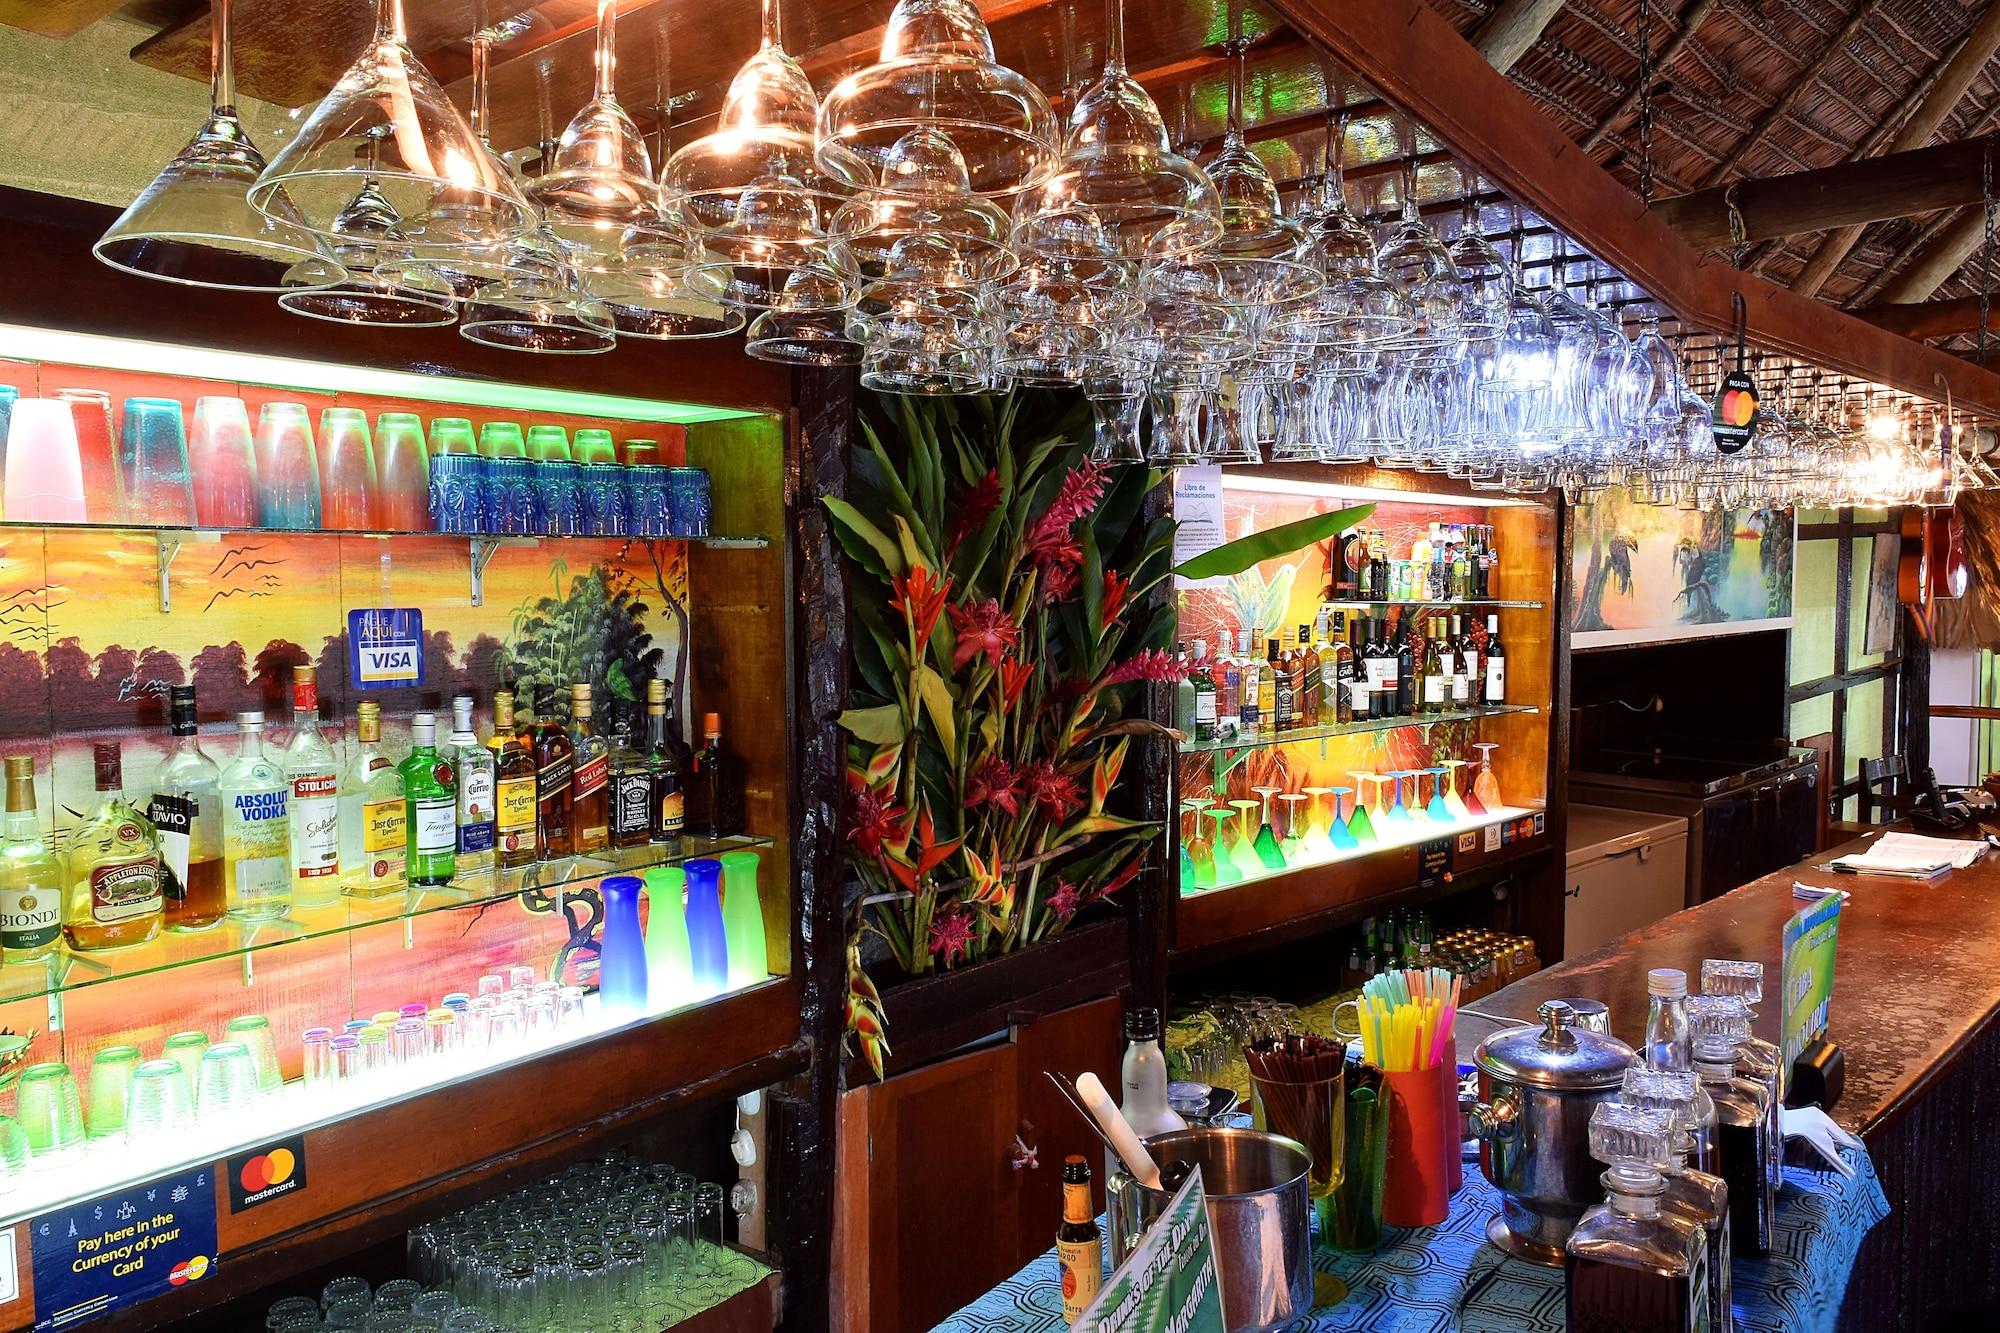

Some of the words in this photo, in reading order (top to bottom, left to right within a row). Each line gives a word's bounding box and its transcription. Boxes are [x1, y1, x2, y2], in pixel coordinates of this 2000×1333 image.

[1175, 491, 1216, 499] Reclamaciones
[359, 617, 389, 627] PAGUE
[368, 652, 412, 669] VISA
[579, 774, 592, 785] Red
[592, 764, 608, 776] Label
[468, 784, 490, 795] Cuervo
[235, 790, 288, 808] ABSOLUT
[504, 798, 518, 808] Jose
[518, 795, 536, 806] Cuervo
[242, 804, 287, 821] VODKA
[372, 819, 386, 832] Jose
[1460, 834, 1475, 848] VISA
[104, 868, 138, 886] APPLETON
[138, 866, 156, 877] ESTATE
[0, 910, 57, 927] BIONDI
[77, 1236, 102, 1253] Pay
[104, 1225, 135, 1244] here
[136, 1220, 150, 1234] in
[151, 1211, 174, 1228] the
[71, 1243, 134, 1273] Currency
[135, 1237, 150, 1252] of
[150, 1227, 181, 1250] your
[112, 1255, 145, 1277] Card
[1098, 1283, 1141, 1333] DRINKS
[1141, 1264, 1155, 1293] OF
[1156, 1241, 1173, 1272] THE
[1172, 1216, 1192, 1253] DAY
[1164, 1255, 1213, 1333] MARGARITA
